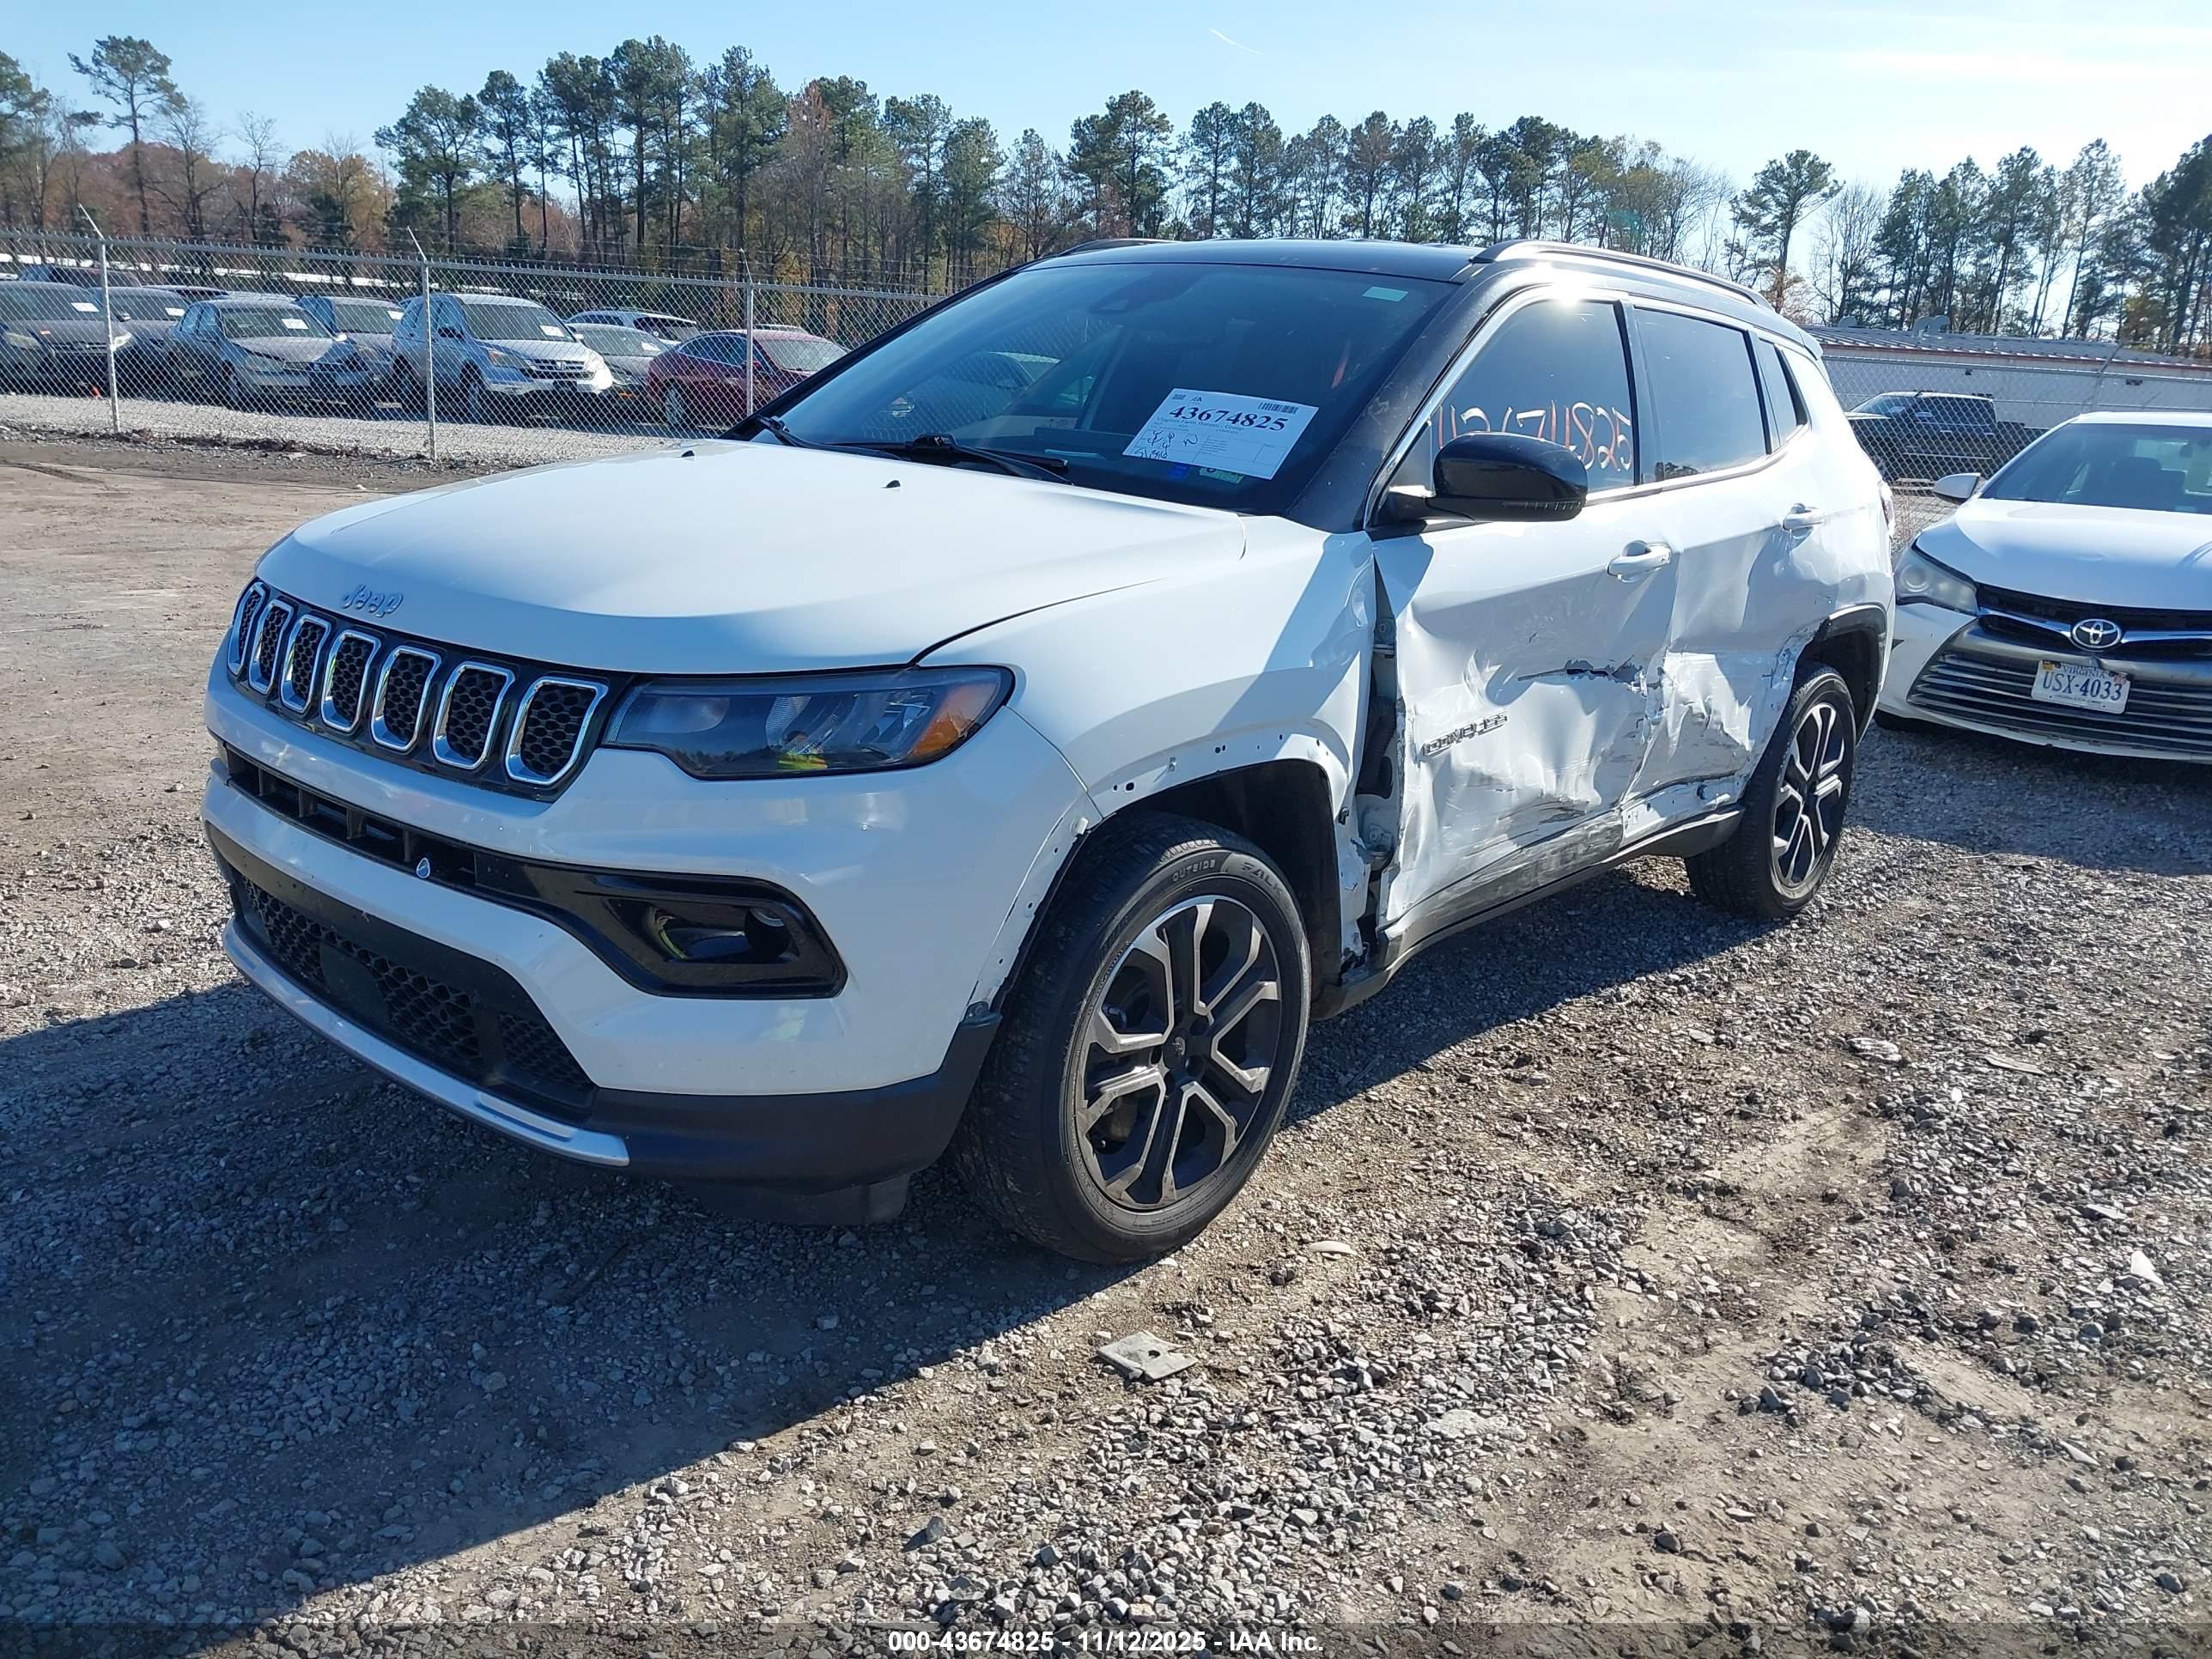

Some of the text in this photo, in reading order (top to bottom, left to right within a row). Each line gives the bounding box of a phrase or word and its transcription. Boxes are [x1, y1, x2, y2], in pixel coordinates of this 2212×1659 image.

[1169, 405, 1288, 432] 43674825
[342, 584, 404, 618] Jeep
[2063, 665, 2106, 679] VIRGINIA
[2042, 671, 2124, 702] USX-4033
[1171, 859, 1216, 883] OUTSIDE
